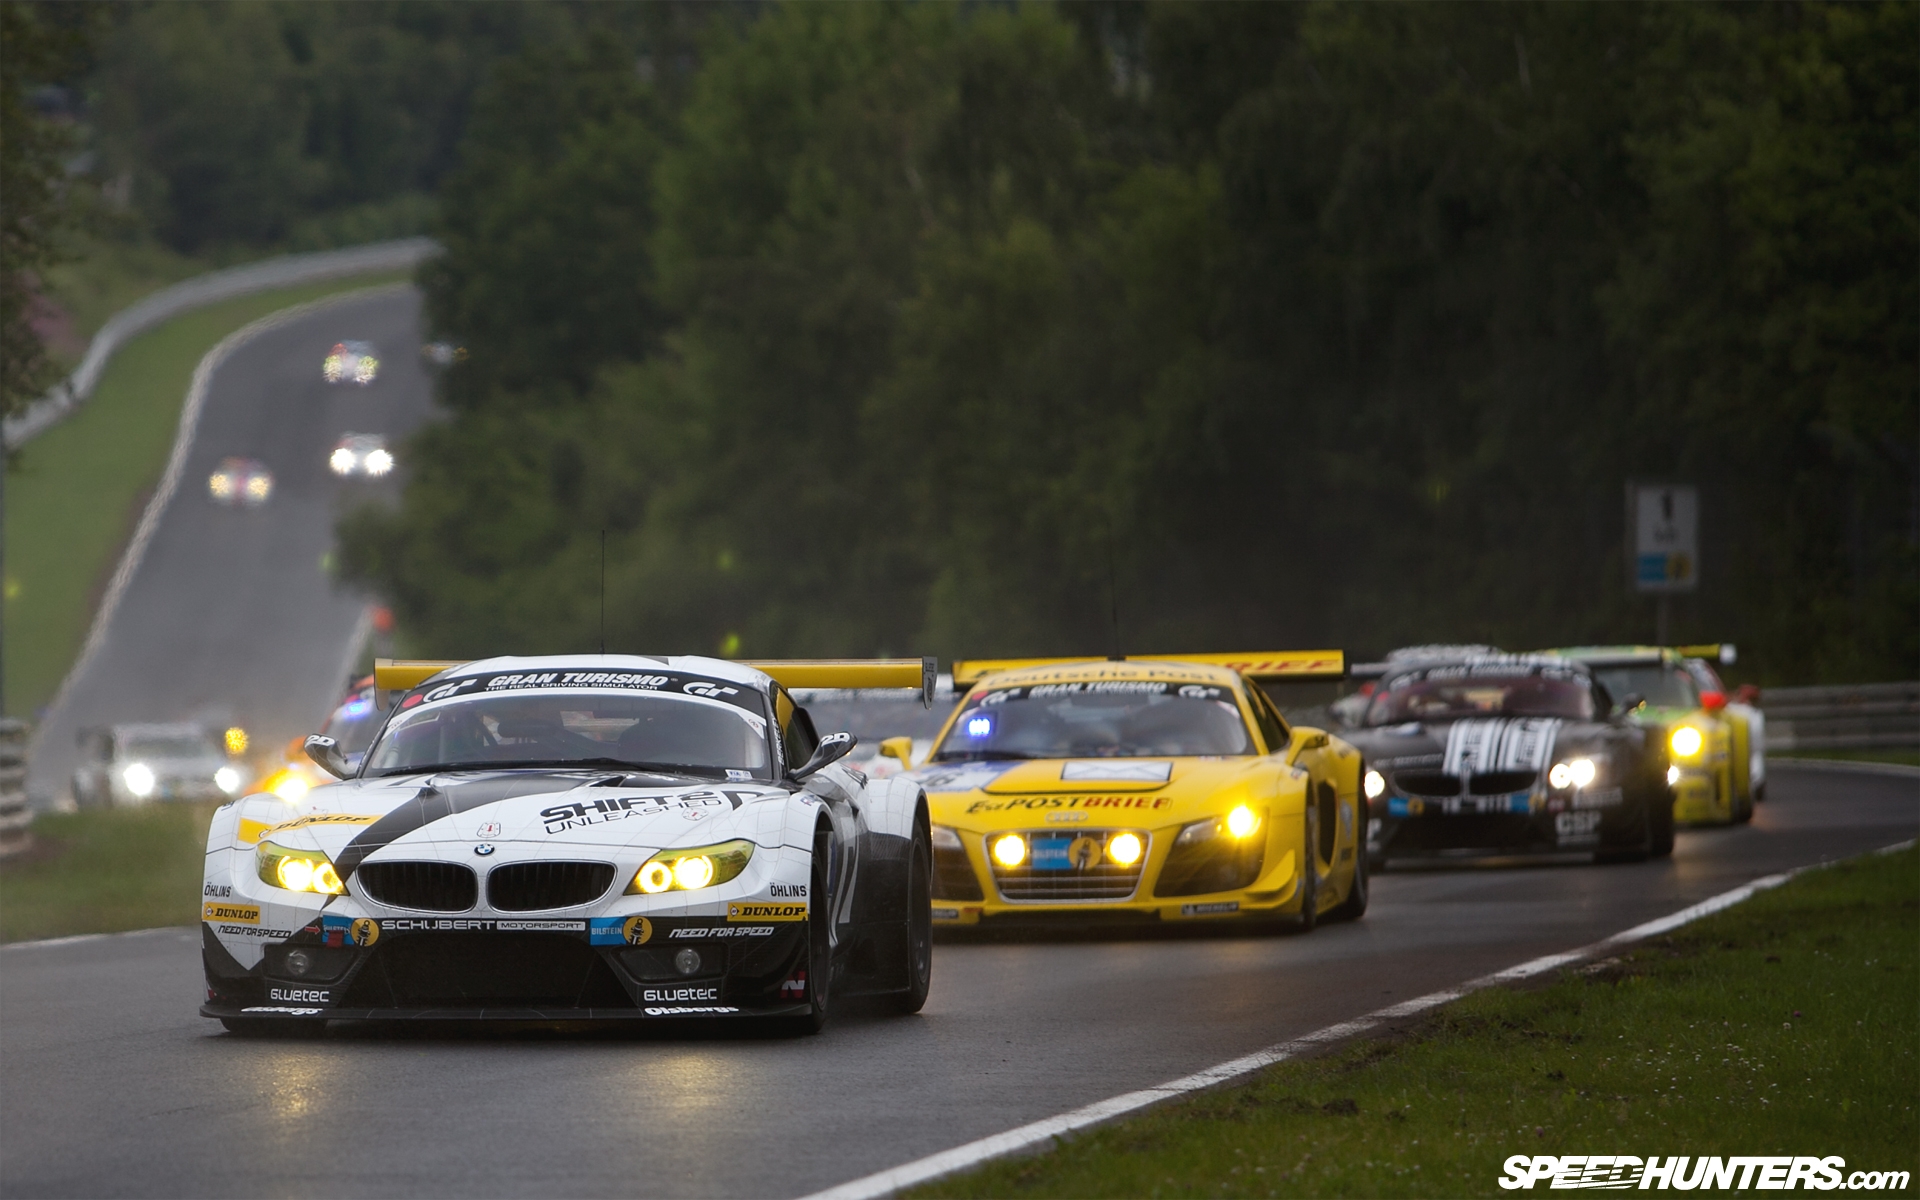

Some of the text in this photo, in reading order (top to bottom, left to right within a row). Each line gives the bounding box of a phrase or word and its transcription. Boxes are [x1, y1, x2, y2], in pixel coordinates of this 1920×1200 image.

[487, 672, 667, 686] GRAN TURISMO
[987, 667, 1137, 688] Deutsche
[1148, 669, 1219, 682] Post
[595, 683, 658, 691] SIMULATOR
[540, 791, 718, 824] SHIFT 2
[546, 798, 721, 835] UNLEASHED
[274, 817, 371, 829] DUNLOP
[203, 881, 232, 897] ÖHLINS
[770, 883, 807, 897] ÖHLINS
[214, 908, 258, 919] DUNLOP
[741, 907, 805, 917] DUNLOP
[380, 920, 582, 930] SCHUBERT MOTORSPORT
[218, 926, 292, 938] NEED FOR SPEED
[591, 927, 622, 936] BILSTEIN
[669, 926, 775, 939] NEED FOR SPEED
